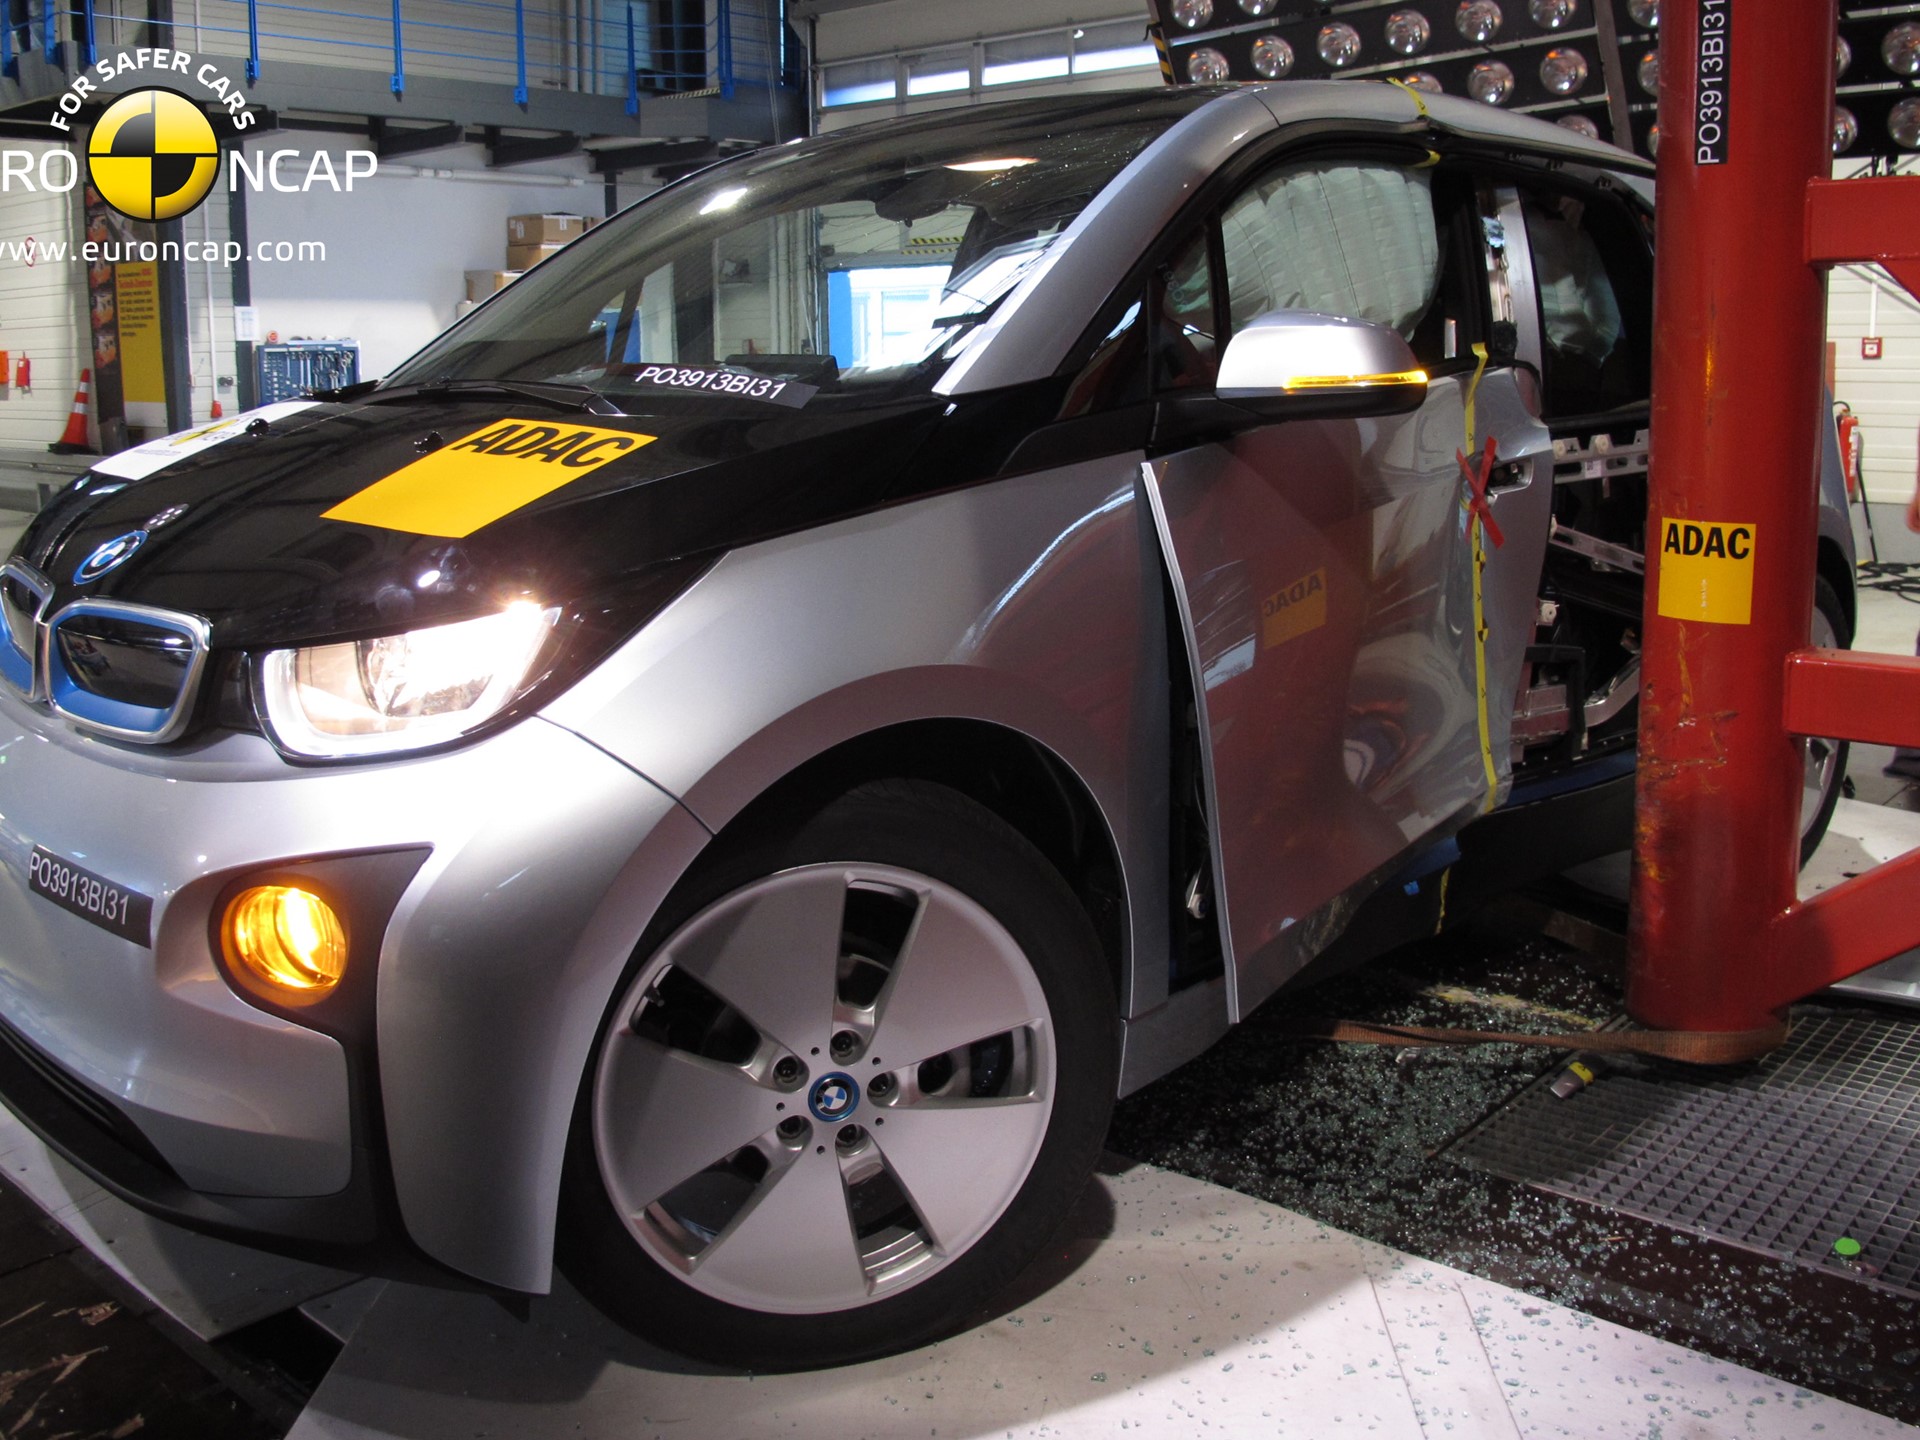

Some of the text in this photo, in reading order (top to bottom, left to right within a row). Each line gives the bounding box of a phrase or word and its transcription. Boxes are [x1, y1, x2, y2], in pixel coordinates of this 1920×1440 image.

[1697, 0, 1725, 164] PO3913BI31
[635, 366, 787, 400] PO3913BI31
[450, 423, 636, 468] ADAC
[1664, 522, 1751, 560] ADAC
[28, 851, 130, 925] PO3913BI31
